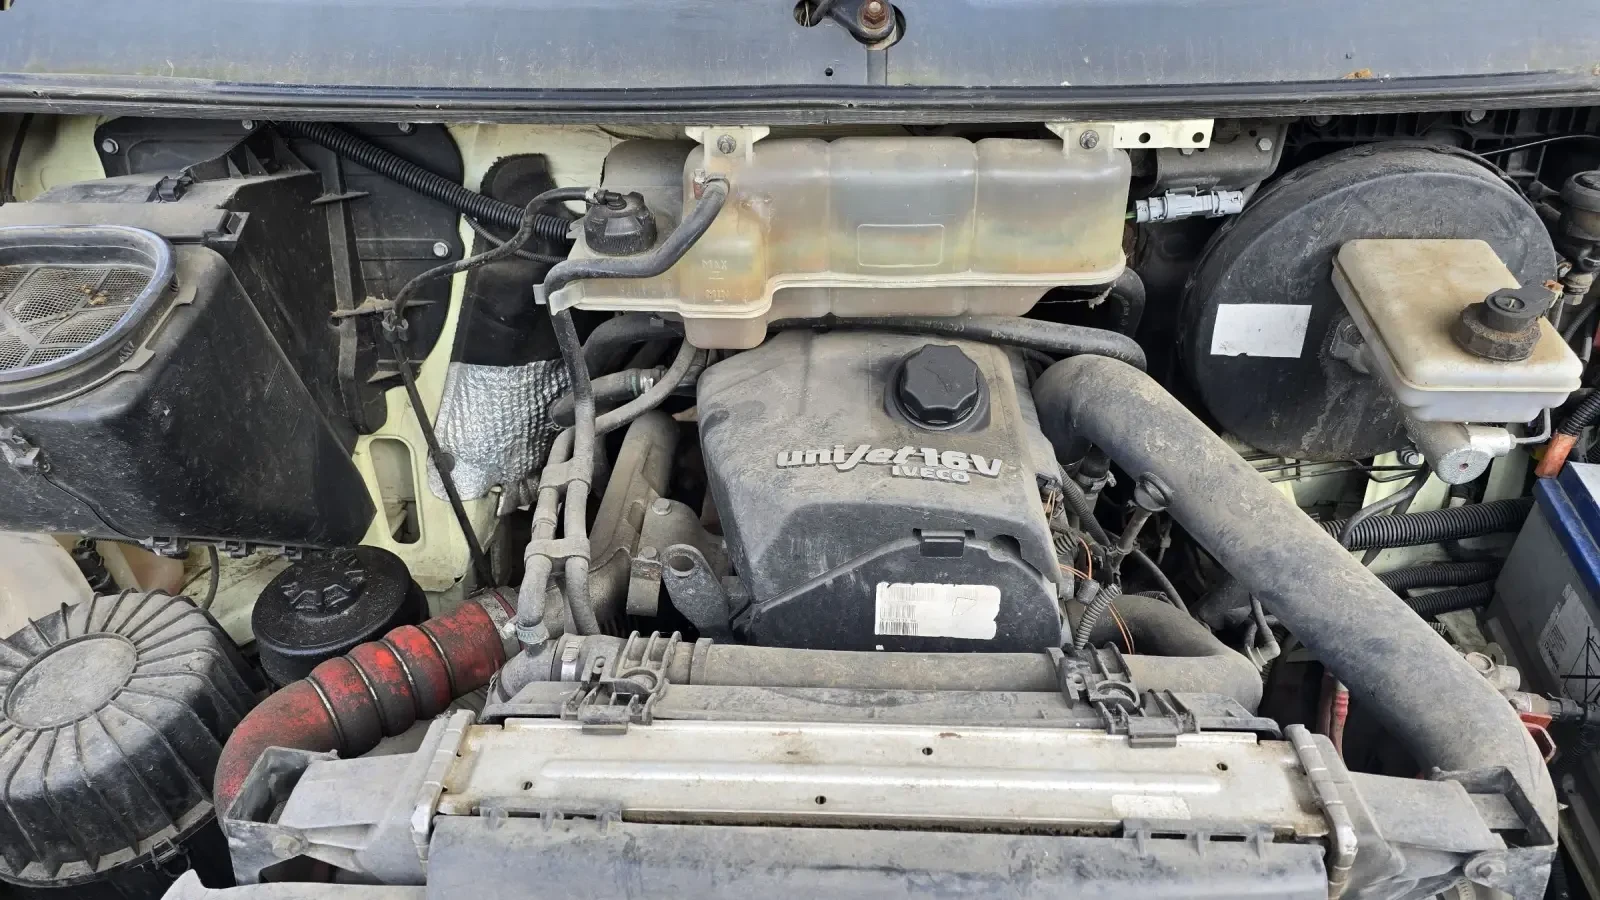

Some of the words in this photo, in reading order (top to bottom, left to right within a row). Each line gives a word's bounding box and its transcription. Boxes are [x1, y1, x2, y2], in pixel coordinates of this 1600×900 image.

[701, 259, 728, 271] MAX
[705, 289, 730, 300] MIN
[891, 465, 971, 484] IVECO
